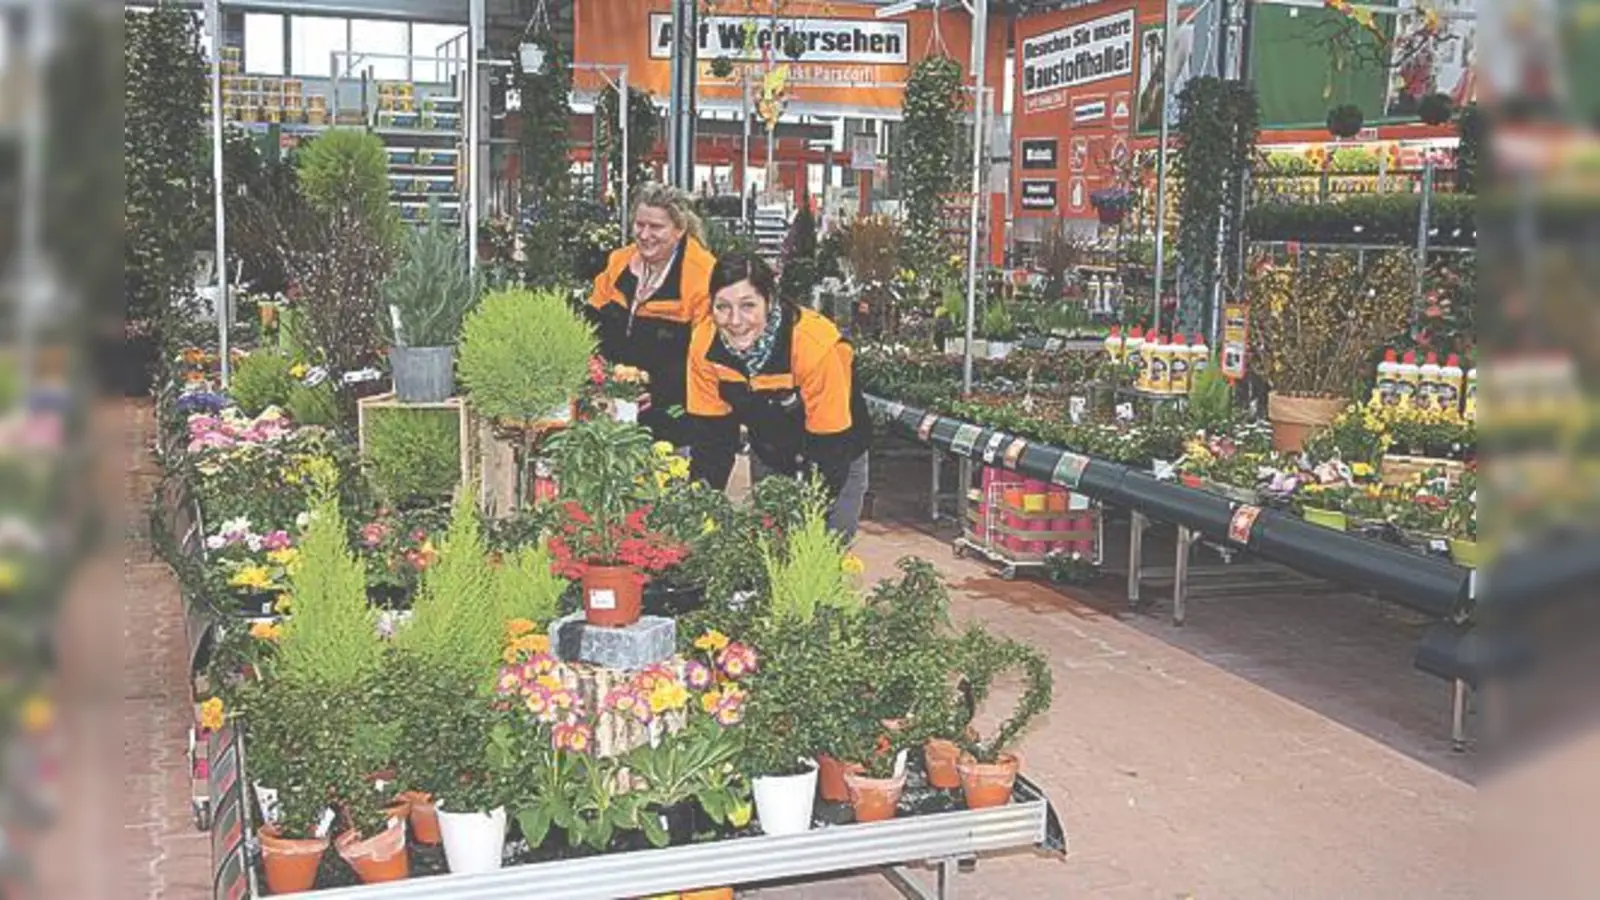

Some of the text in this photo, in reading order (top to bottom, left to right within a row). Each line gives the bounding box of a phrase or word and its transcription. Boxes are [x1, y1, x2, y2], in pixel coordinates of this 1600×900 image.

[658, 23, 900, 53] Af Wedrsehen
[1073, 27, 1092, 47] Sie
[1025, 41, 1130, 90] Baustoffhalle!
